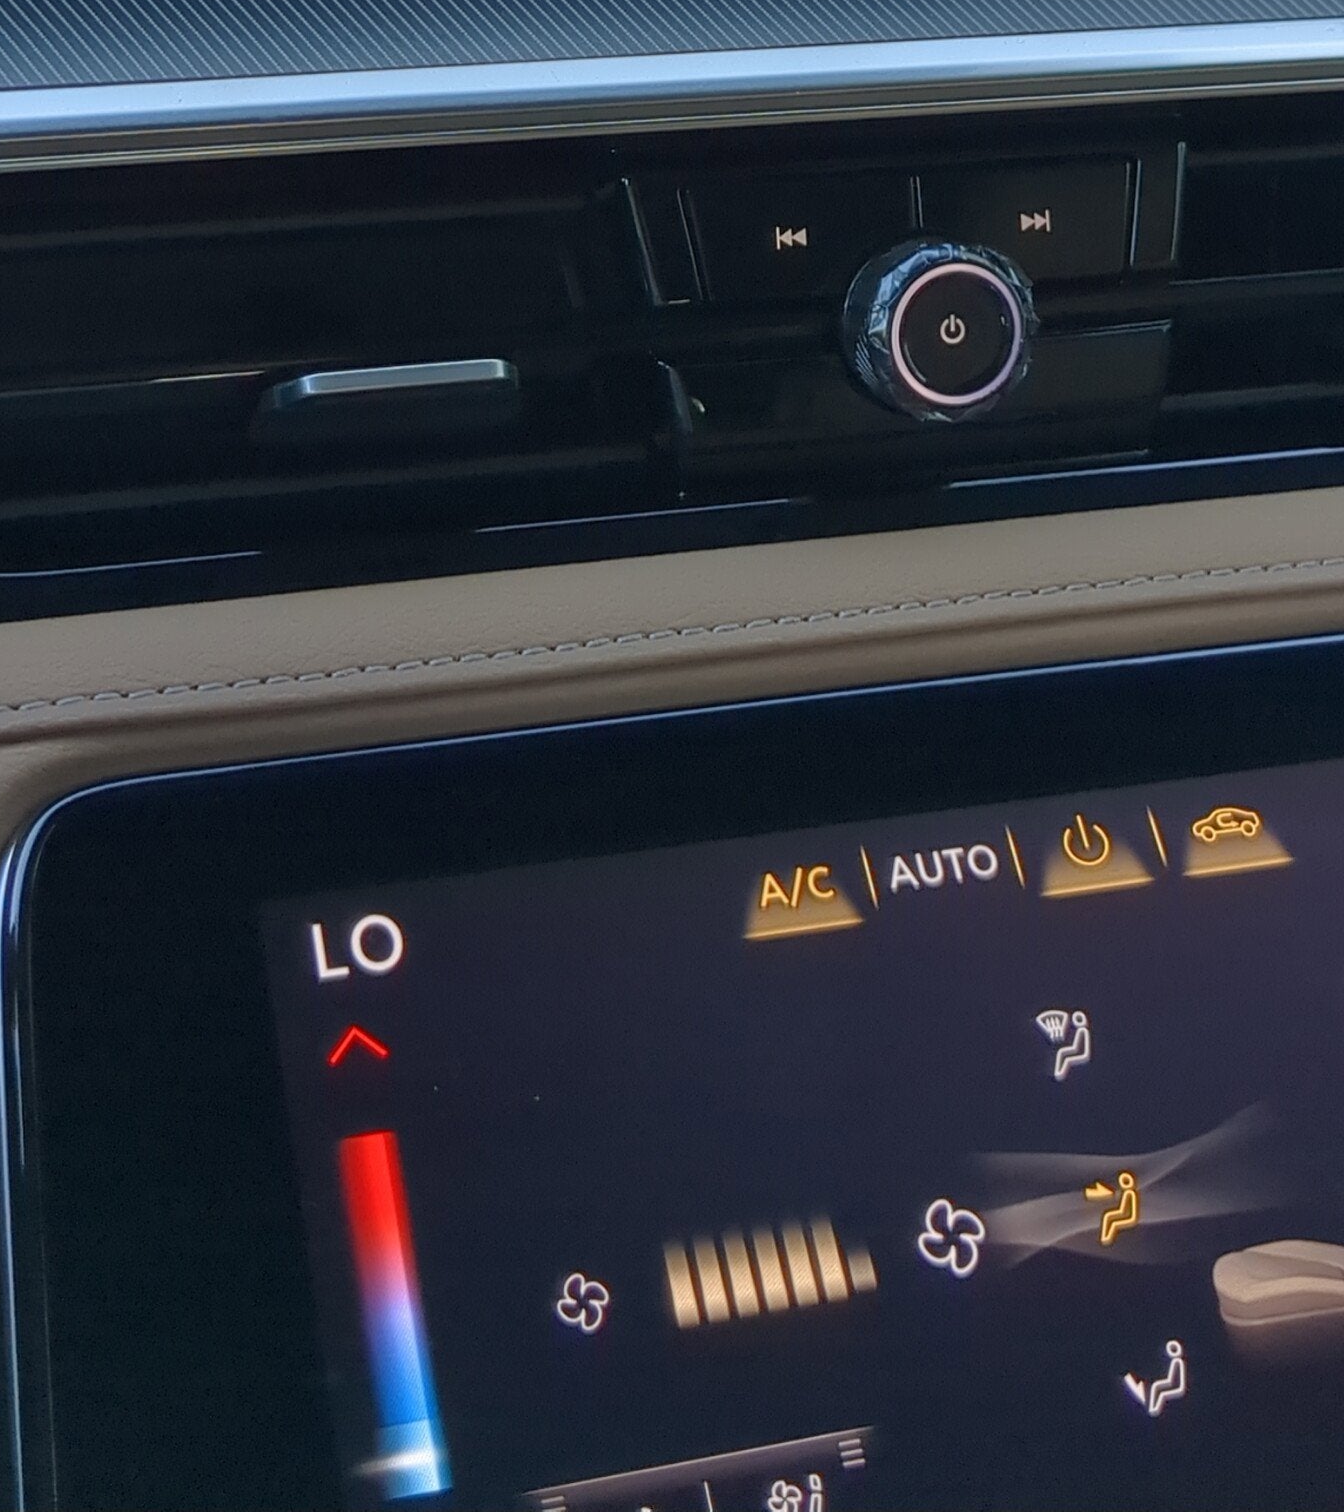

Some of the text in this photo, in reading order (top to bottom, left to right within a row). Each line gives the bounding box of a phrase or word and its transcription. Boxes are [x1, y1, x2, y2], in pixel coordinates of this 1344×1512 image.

[759, 864, 837, 910] A/C
[889, 843, 1000, 893] AUTO
[311, 913, 405, 983] LO
